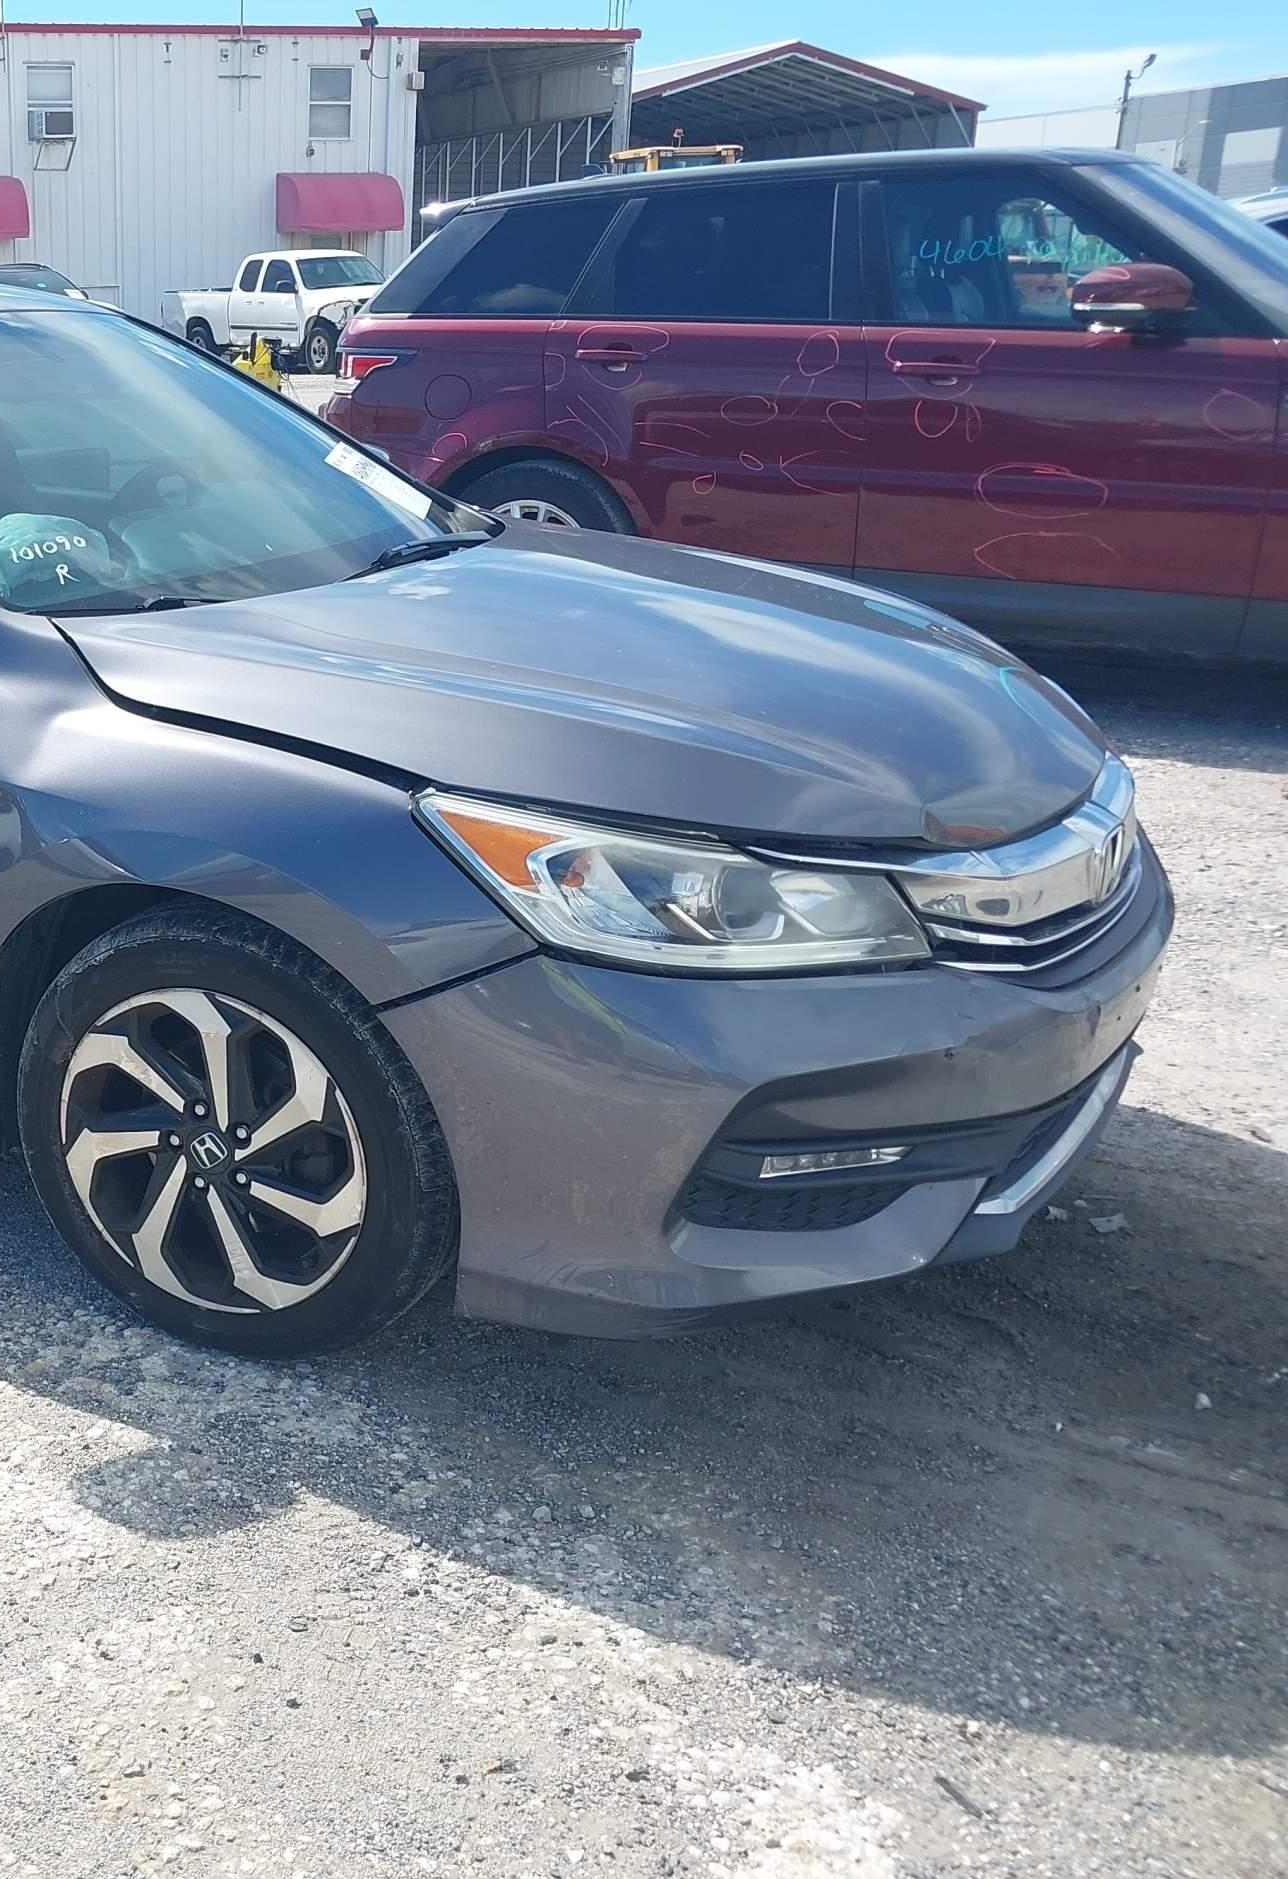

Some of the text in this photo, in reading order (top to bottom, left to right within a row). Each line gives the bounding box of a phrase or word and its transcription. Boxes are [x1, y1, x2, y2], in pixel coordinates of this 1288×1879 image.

[919, 235, 1003, 264] 4604
[10, 535, 87, 564] 101090
[55, 563, 81, 585] R
